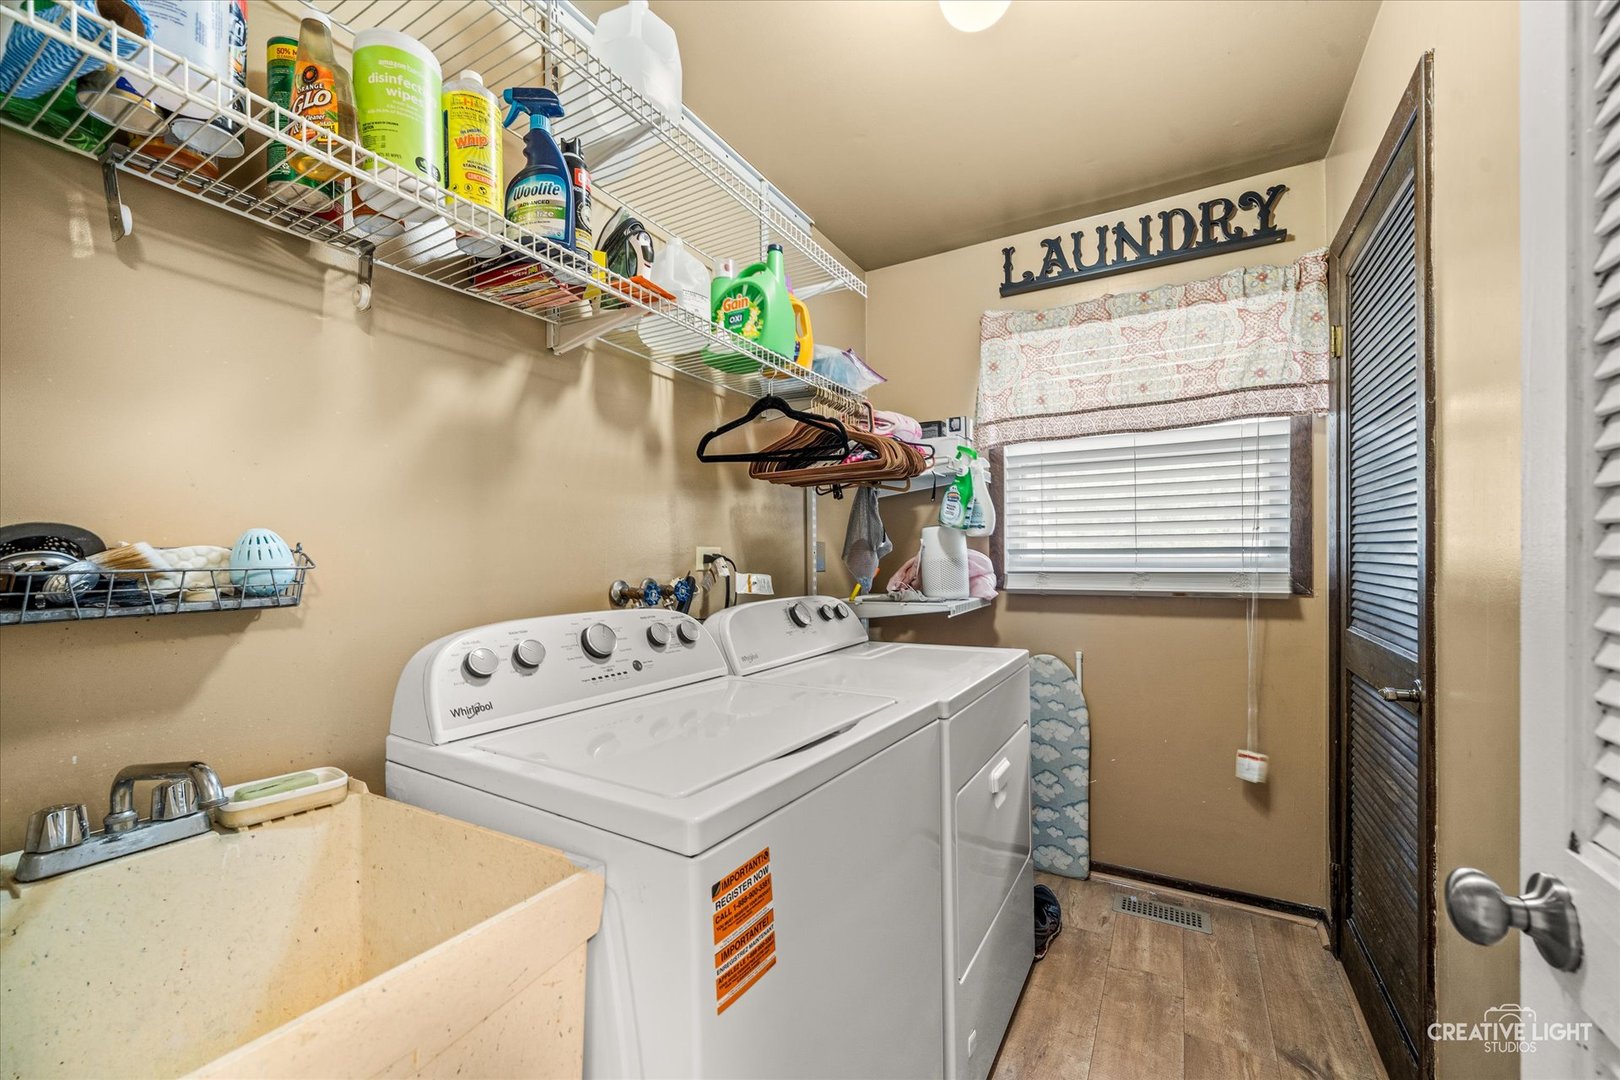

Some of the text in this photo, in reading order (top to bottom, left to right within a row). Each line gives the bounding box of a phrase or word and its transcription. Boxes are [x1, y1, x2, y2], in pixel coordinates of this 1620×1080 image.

[292, 89, 333, 115] GLO
[513, 182, 560, 201] Woolite
[1000, 184, 1287, 288] LAUNDRY
[723, 294, 749, 312] Gain
[729, 314, 743, 324] OXI
[450, 701, 493, 719] Whirlpool
[715, 864, 769, 911] REGISTER NOW
[715, 909, 732, 924] CALL
